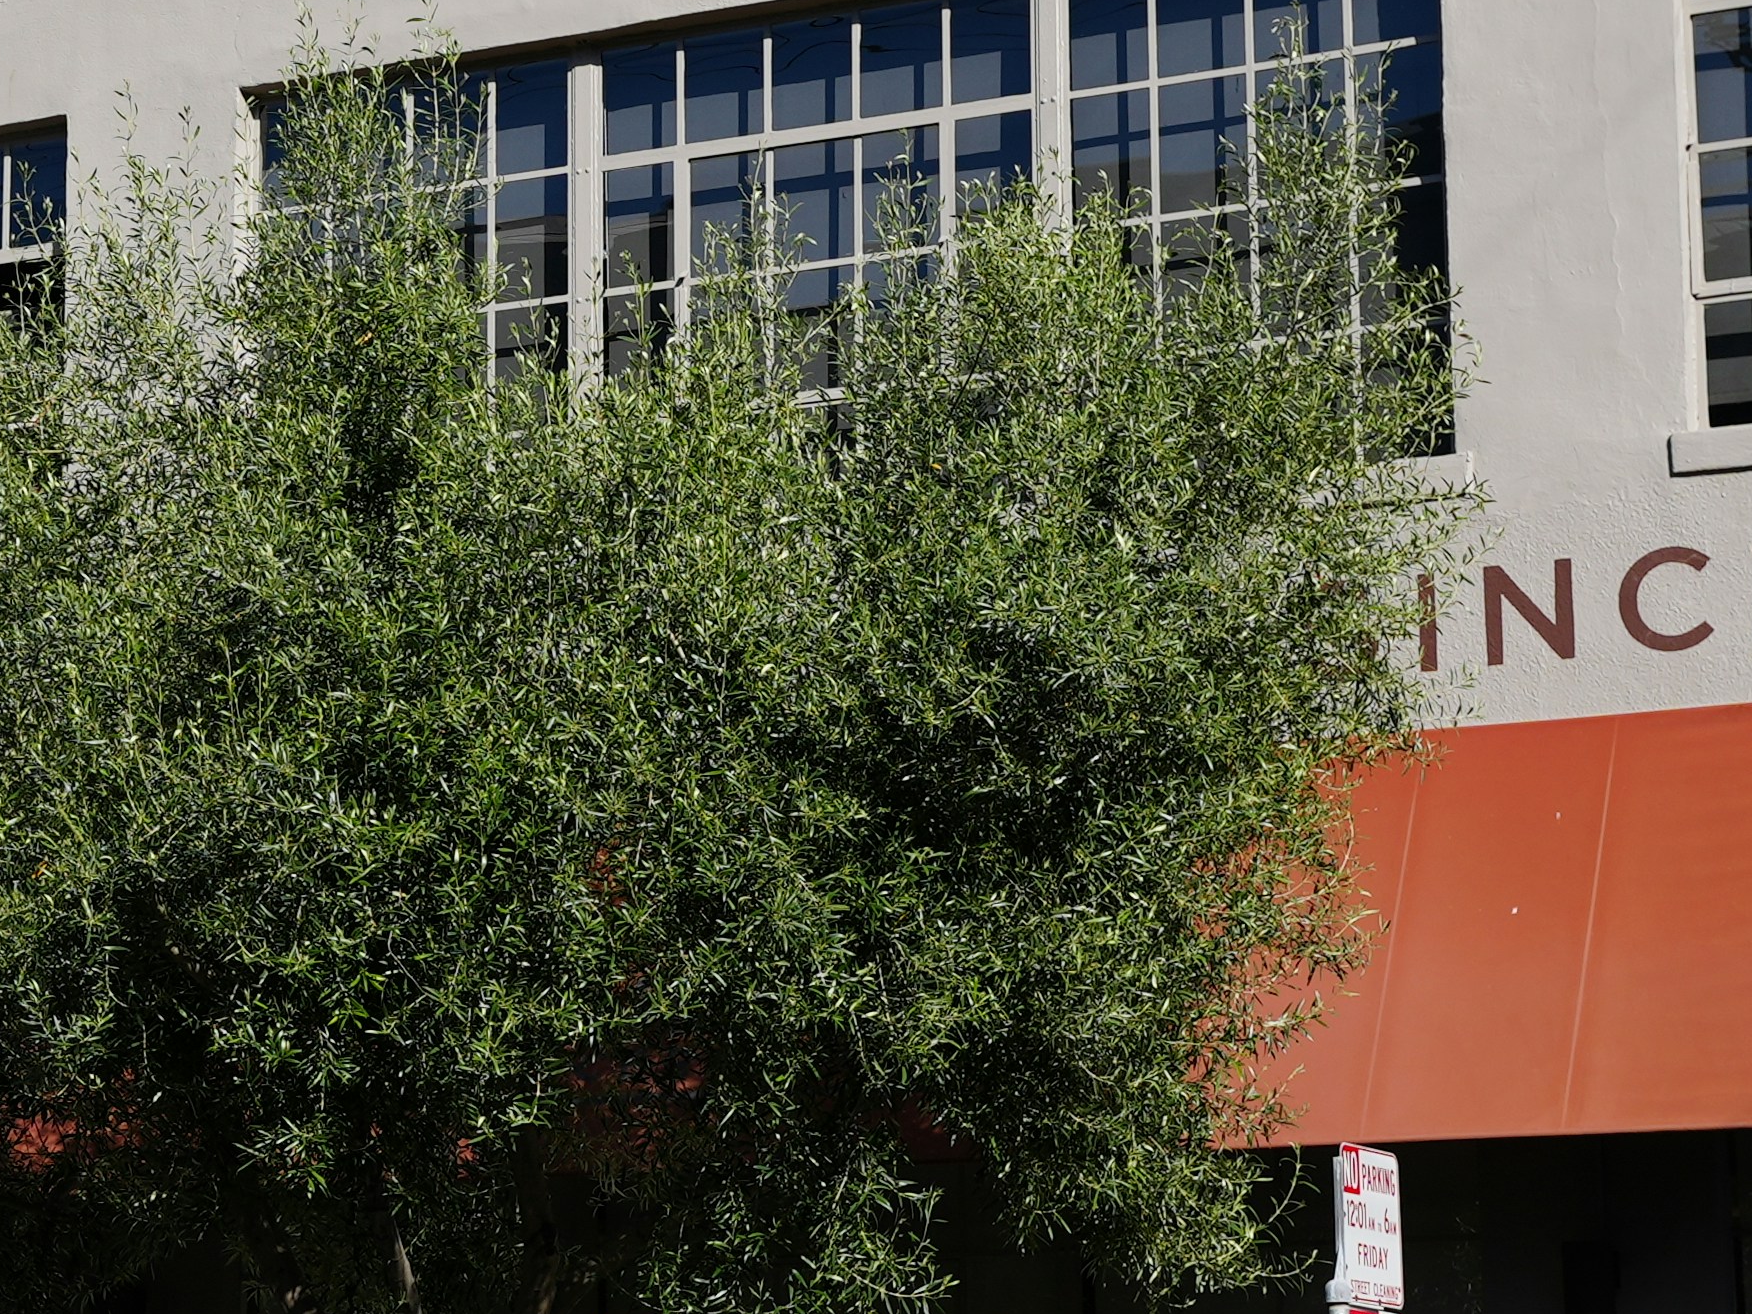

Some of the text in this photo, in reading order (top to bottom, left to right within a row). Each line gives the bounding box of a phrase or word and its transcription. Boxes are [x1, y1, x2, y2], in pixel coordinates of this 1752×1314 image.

[1343, 1149, 1396, 1197] NO PARKING
[1358, 1243, 1388, 1270] FRIDAY
[1350, 1279, 1399, 1300] STREET CLEANING
